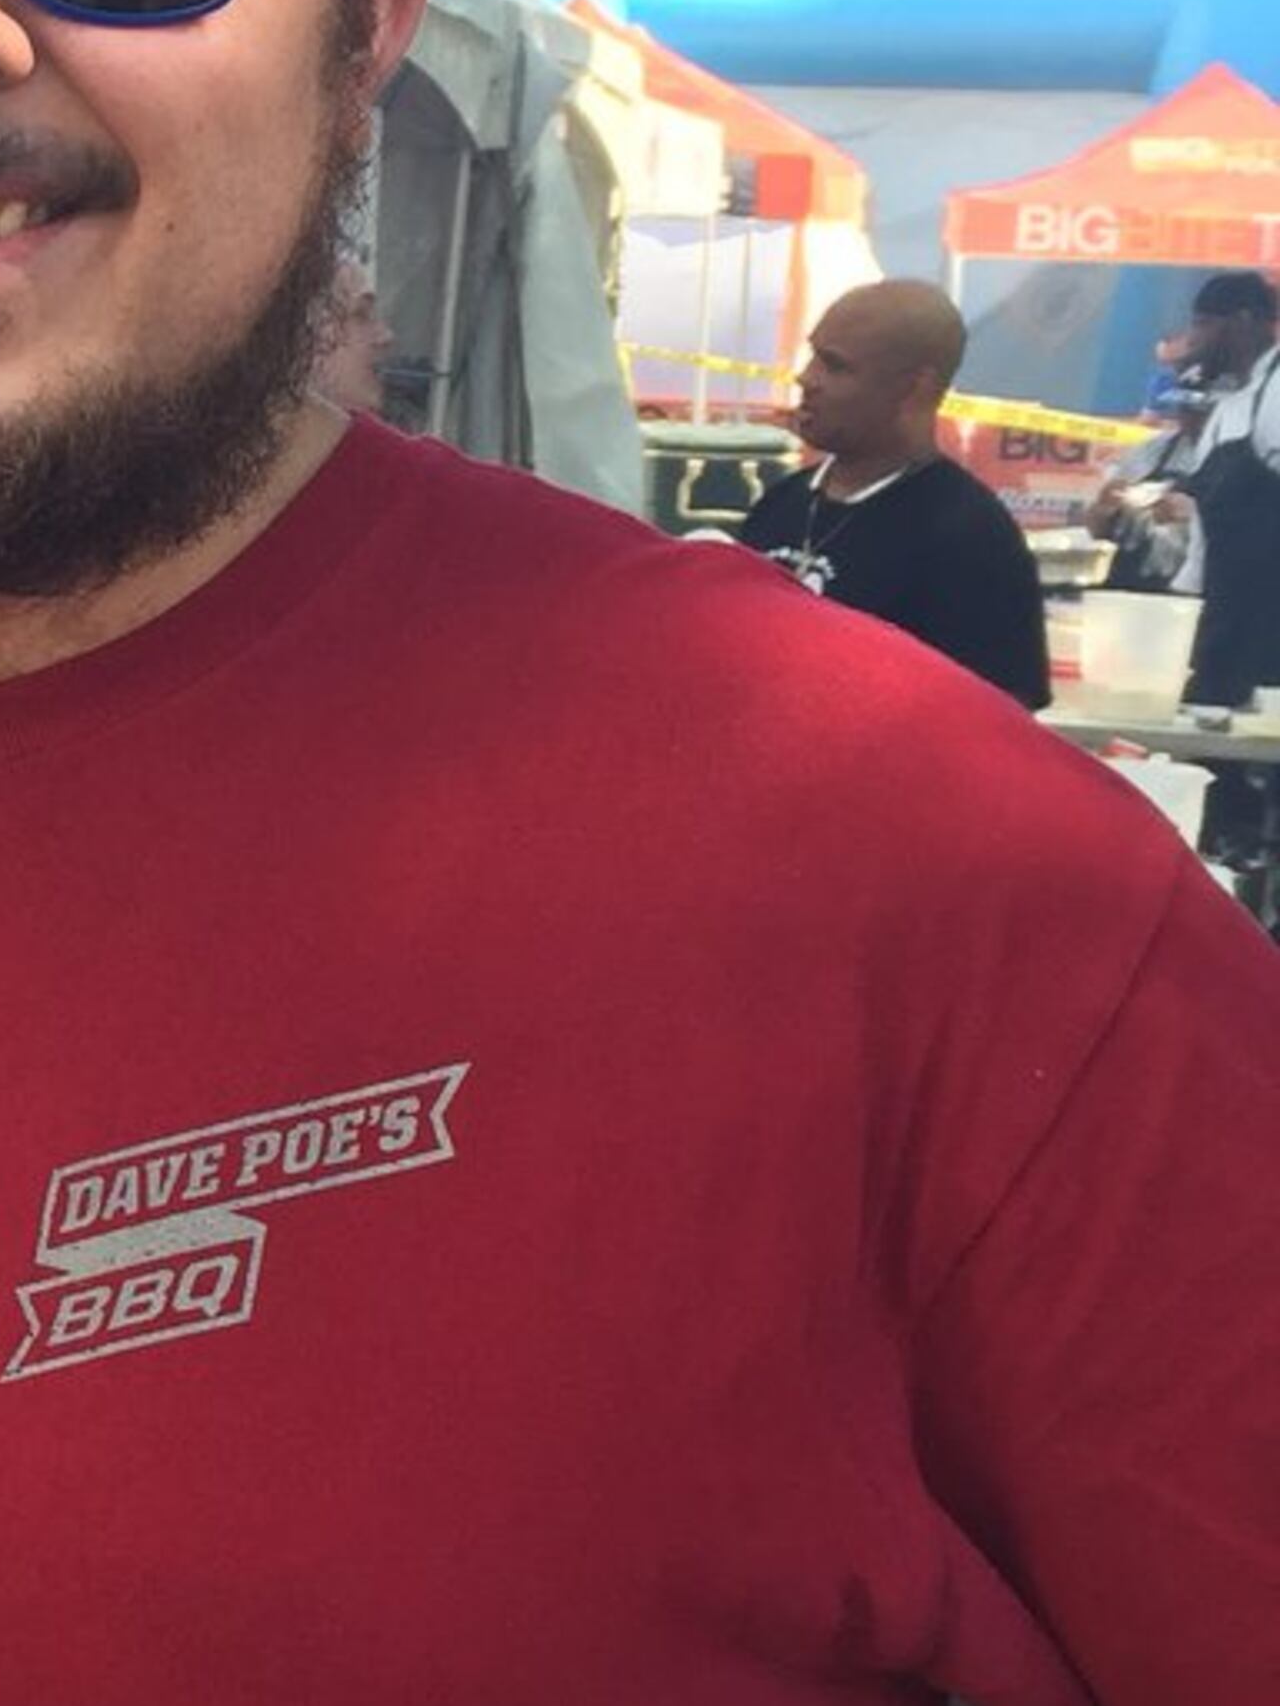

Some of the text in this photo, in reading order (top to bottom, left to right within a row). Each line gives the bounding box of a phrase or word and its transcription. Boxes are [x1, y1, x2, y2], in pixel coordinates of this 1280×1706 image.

[1015, 204, 1121, 254] BIG
[59, 1095, 421, 1233] DAVE POE'S
[46, 1254, 240, 1346] BBQ
